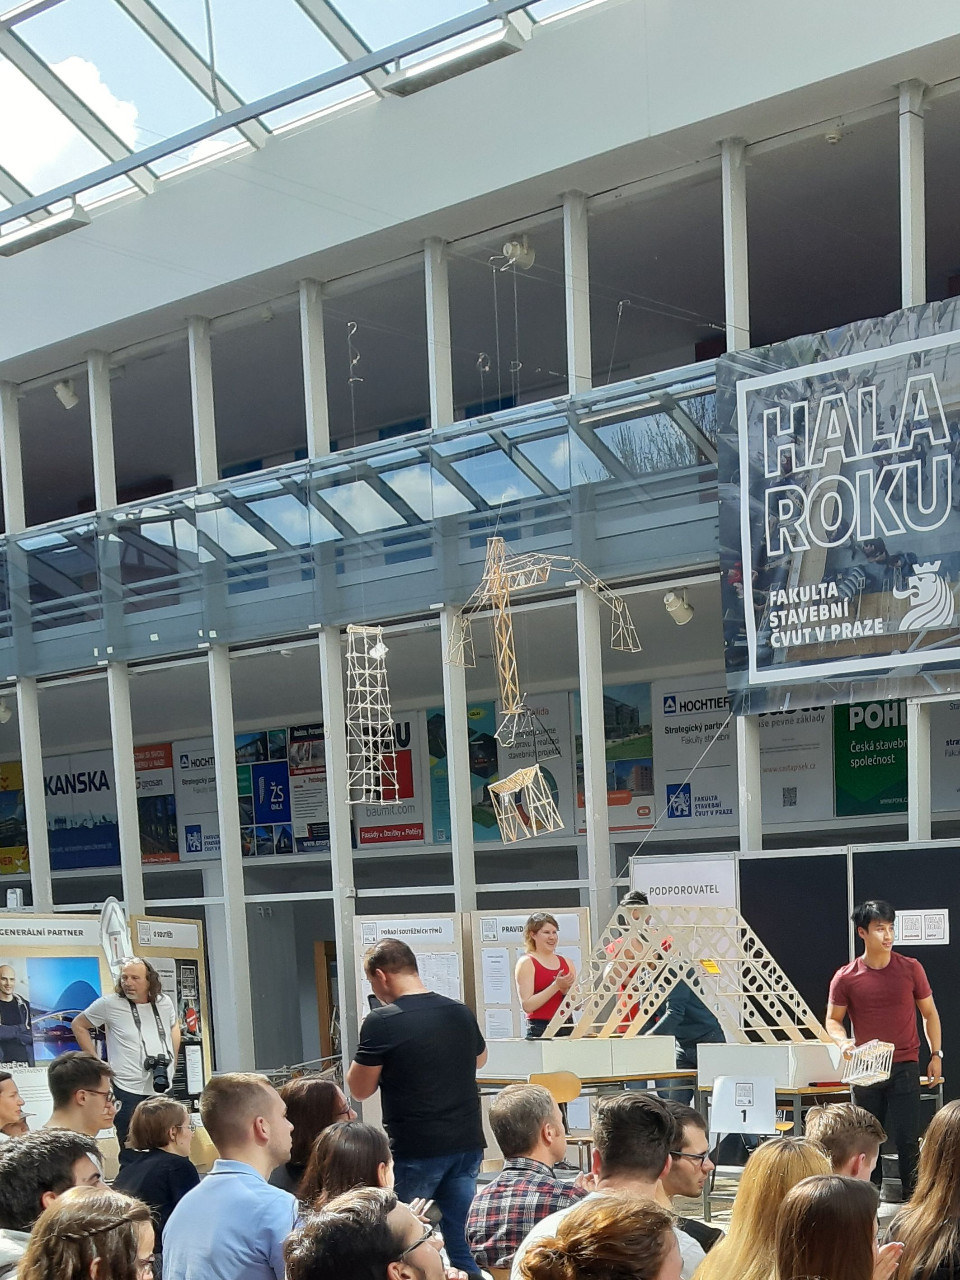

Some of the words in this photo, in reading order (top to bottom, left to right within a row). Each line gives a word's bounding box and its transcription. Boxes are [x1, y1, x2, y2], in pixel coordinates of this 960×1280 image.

[763, 373, 951, 479] HALA
[765, 453, 952, 557] ROKU
[770, 581, 838, 607] FAKULTA
[769, 596, 850, 627] STAVEBNÍ
[770, 626, 812, 648] ČVUT
[814, 626, 826, 642] V
[831, 617, 884, 640] PRAZE
[679, 696, 729, 712] HOCHTIEF
[796, 713, 826, 725] základy
[664, 722, 703, 735] Strategický
[851, 741, 874, 752] Česká
[876, 738, 907, 750] stavebn
[851, 754, 895, 768] společnost
[44, 770, 110, 796] KANSKA
[270, 781, 284, 802] ŽS
[366, 804, 415, 817] baumit.com
[650, 885, 719, 896] PODPOROVATEL
[0, 928, 45, 937] GENERÁLNÍ
[0, 1061, 29, 1071] SPĚCH
[741, 1109, 747, 1123] 1
